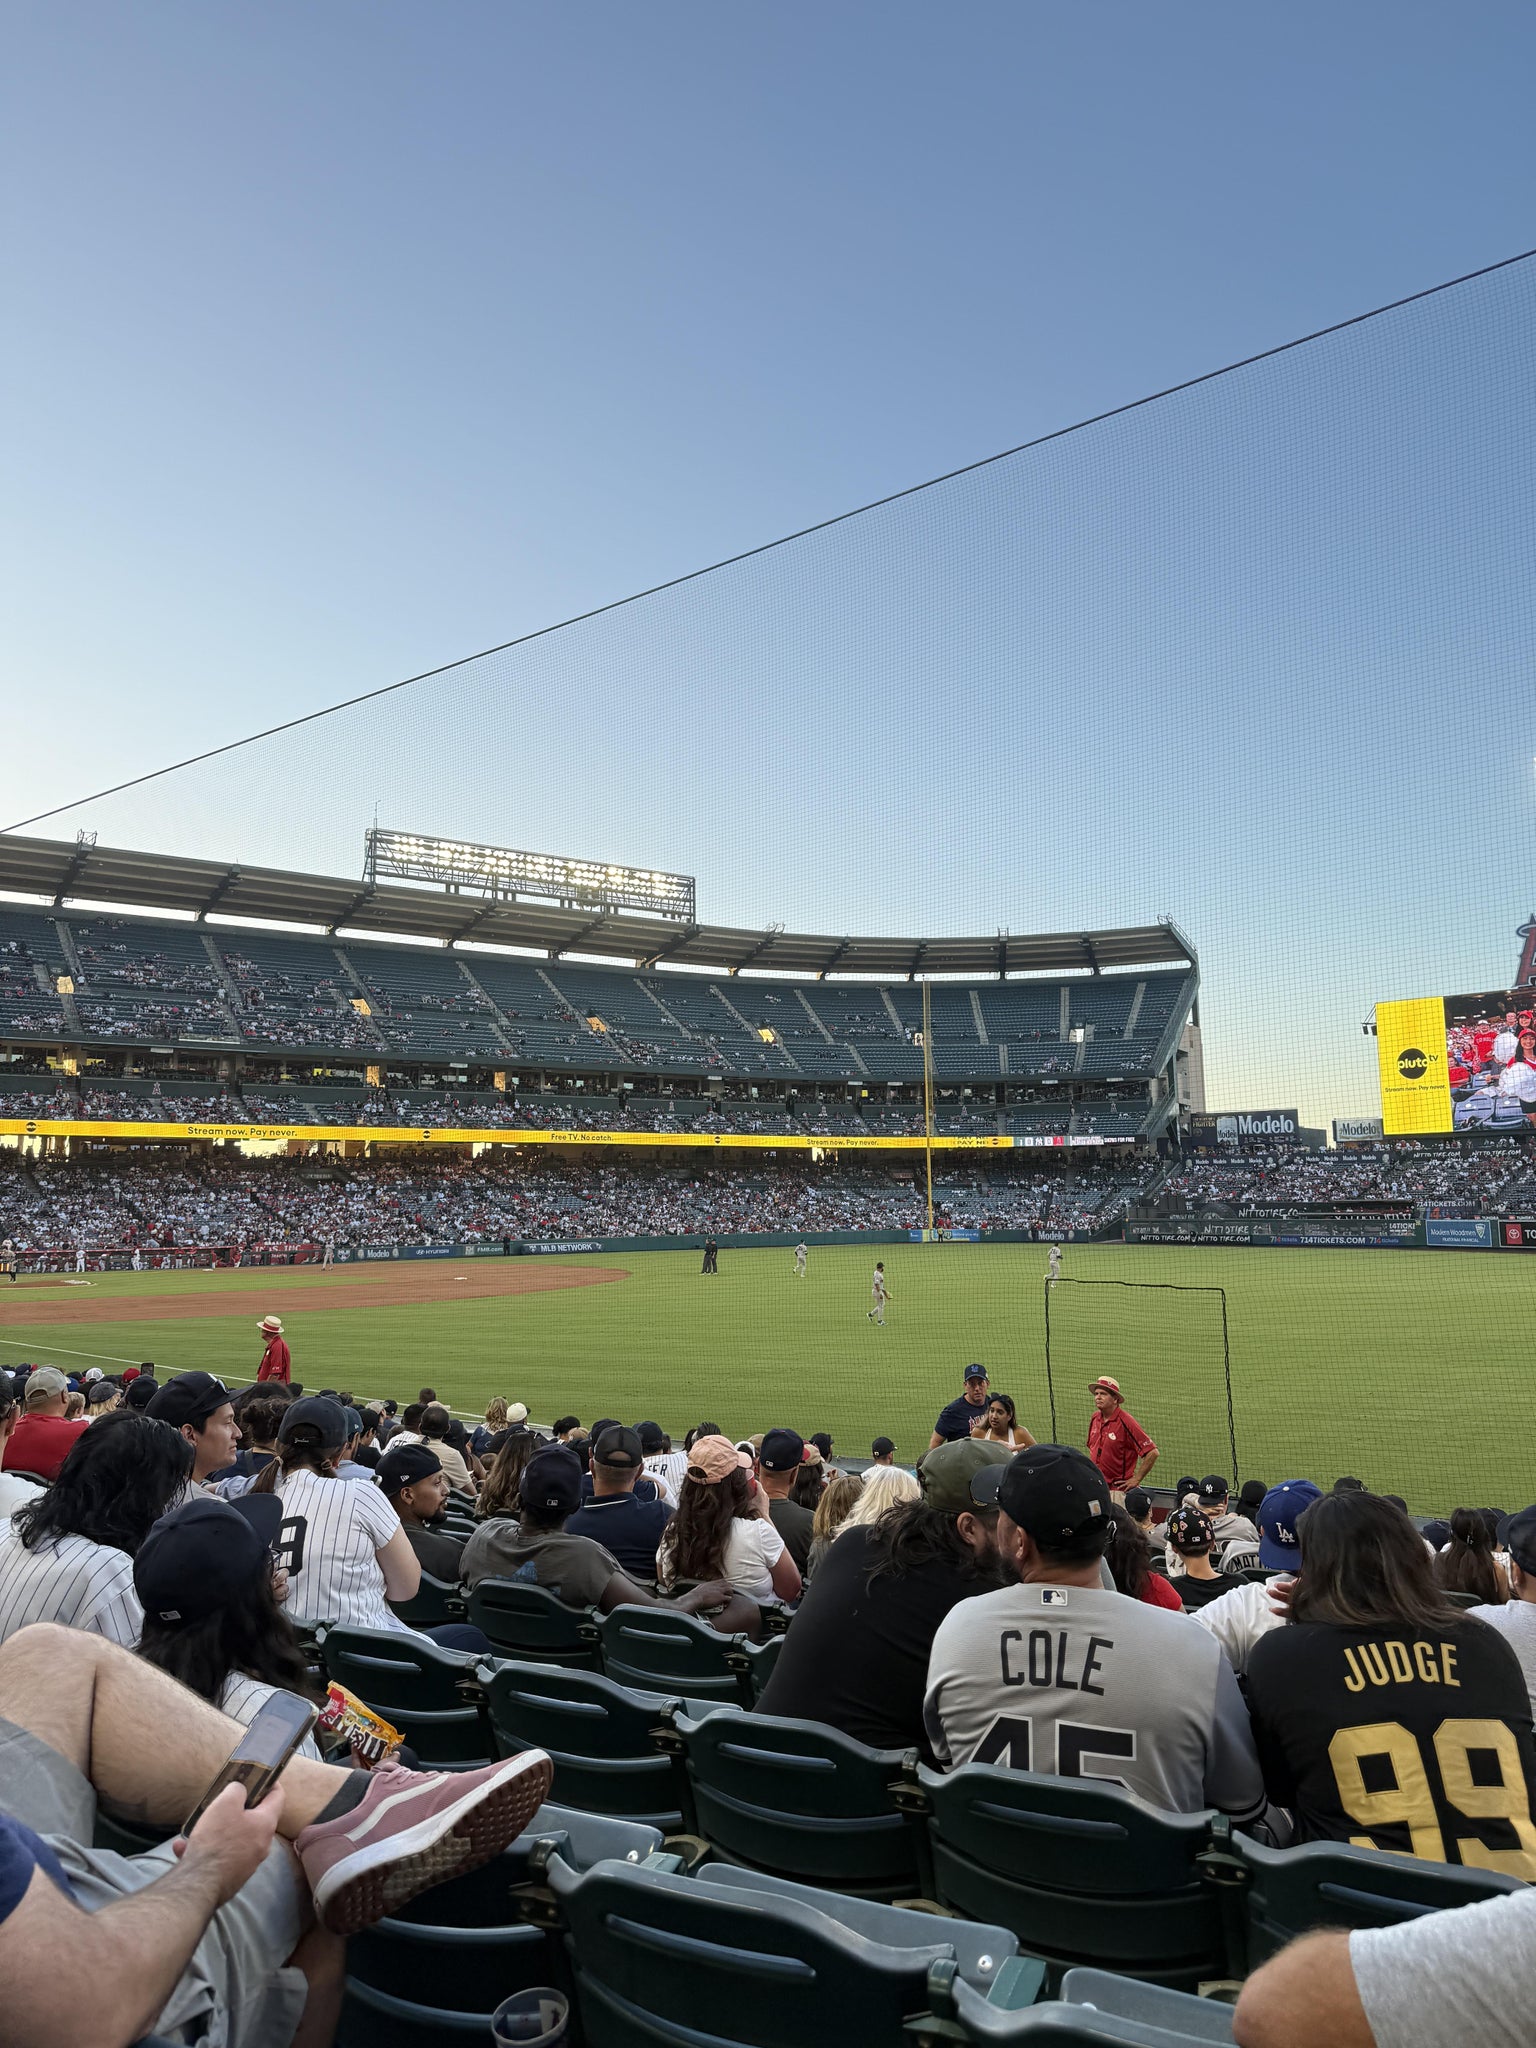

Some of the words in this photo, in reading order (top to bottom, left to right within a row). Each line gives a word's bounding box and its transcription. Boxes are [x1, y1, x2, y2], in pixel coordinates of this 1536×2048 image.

[1238, 1115, 1294, 1134] Modelo
[1343, 1123, 1376, 1135] Modelo
[188, 1126, 223, 1135] Stream
[225, 1128, 247, 1136] now.
[250, 1128, 267, 1137] Pay
[551, 1133, 566, 1141] Free
[591, 1134, 614, 1142] catch.
[846, 1139, 858, 1147] Pay
[1038, 1231, 1064, 1240] Modelo
[1300, 1236, 1366, 1244] 714TICKETS.COM
[541, 1244, 557, 1252] MLB
[557, 1243, 592, 1252] NETWORK
[367, 1250, 389, 1258] Modelo
[1275, 1522, 1295, 1543] LA
[1000, 1629, 1114, 1696] COLE
[1343, 1641, 1461, 1692] JUDGE
[1328, 1718, 1536, 1882] 99
